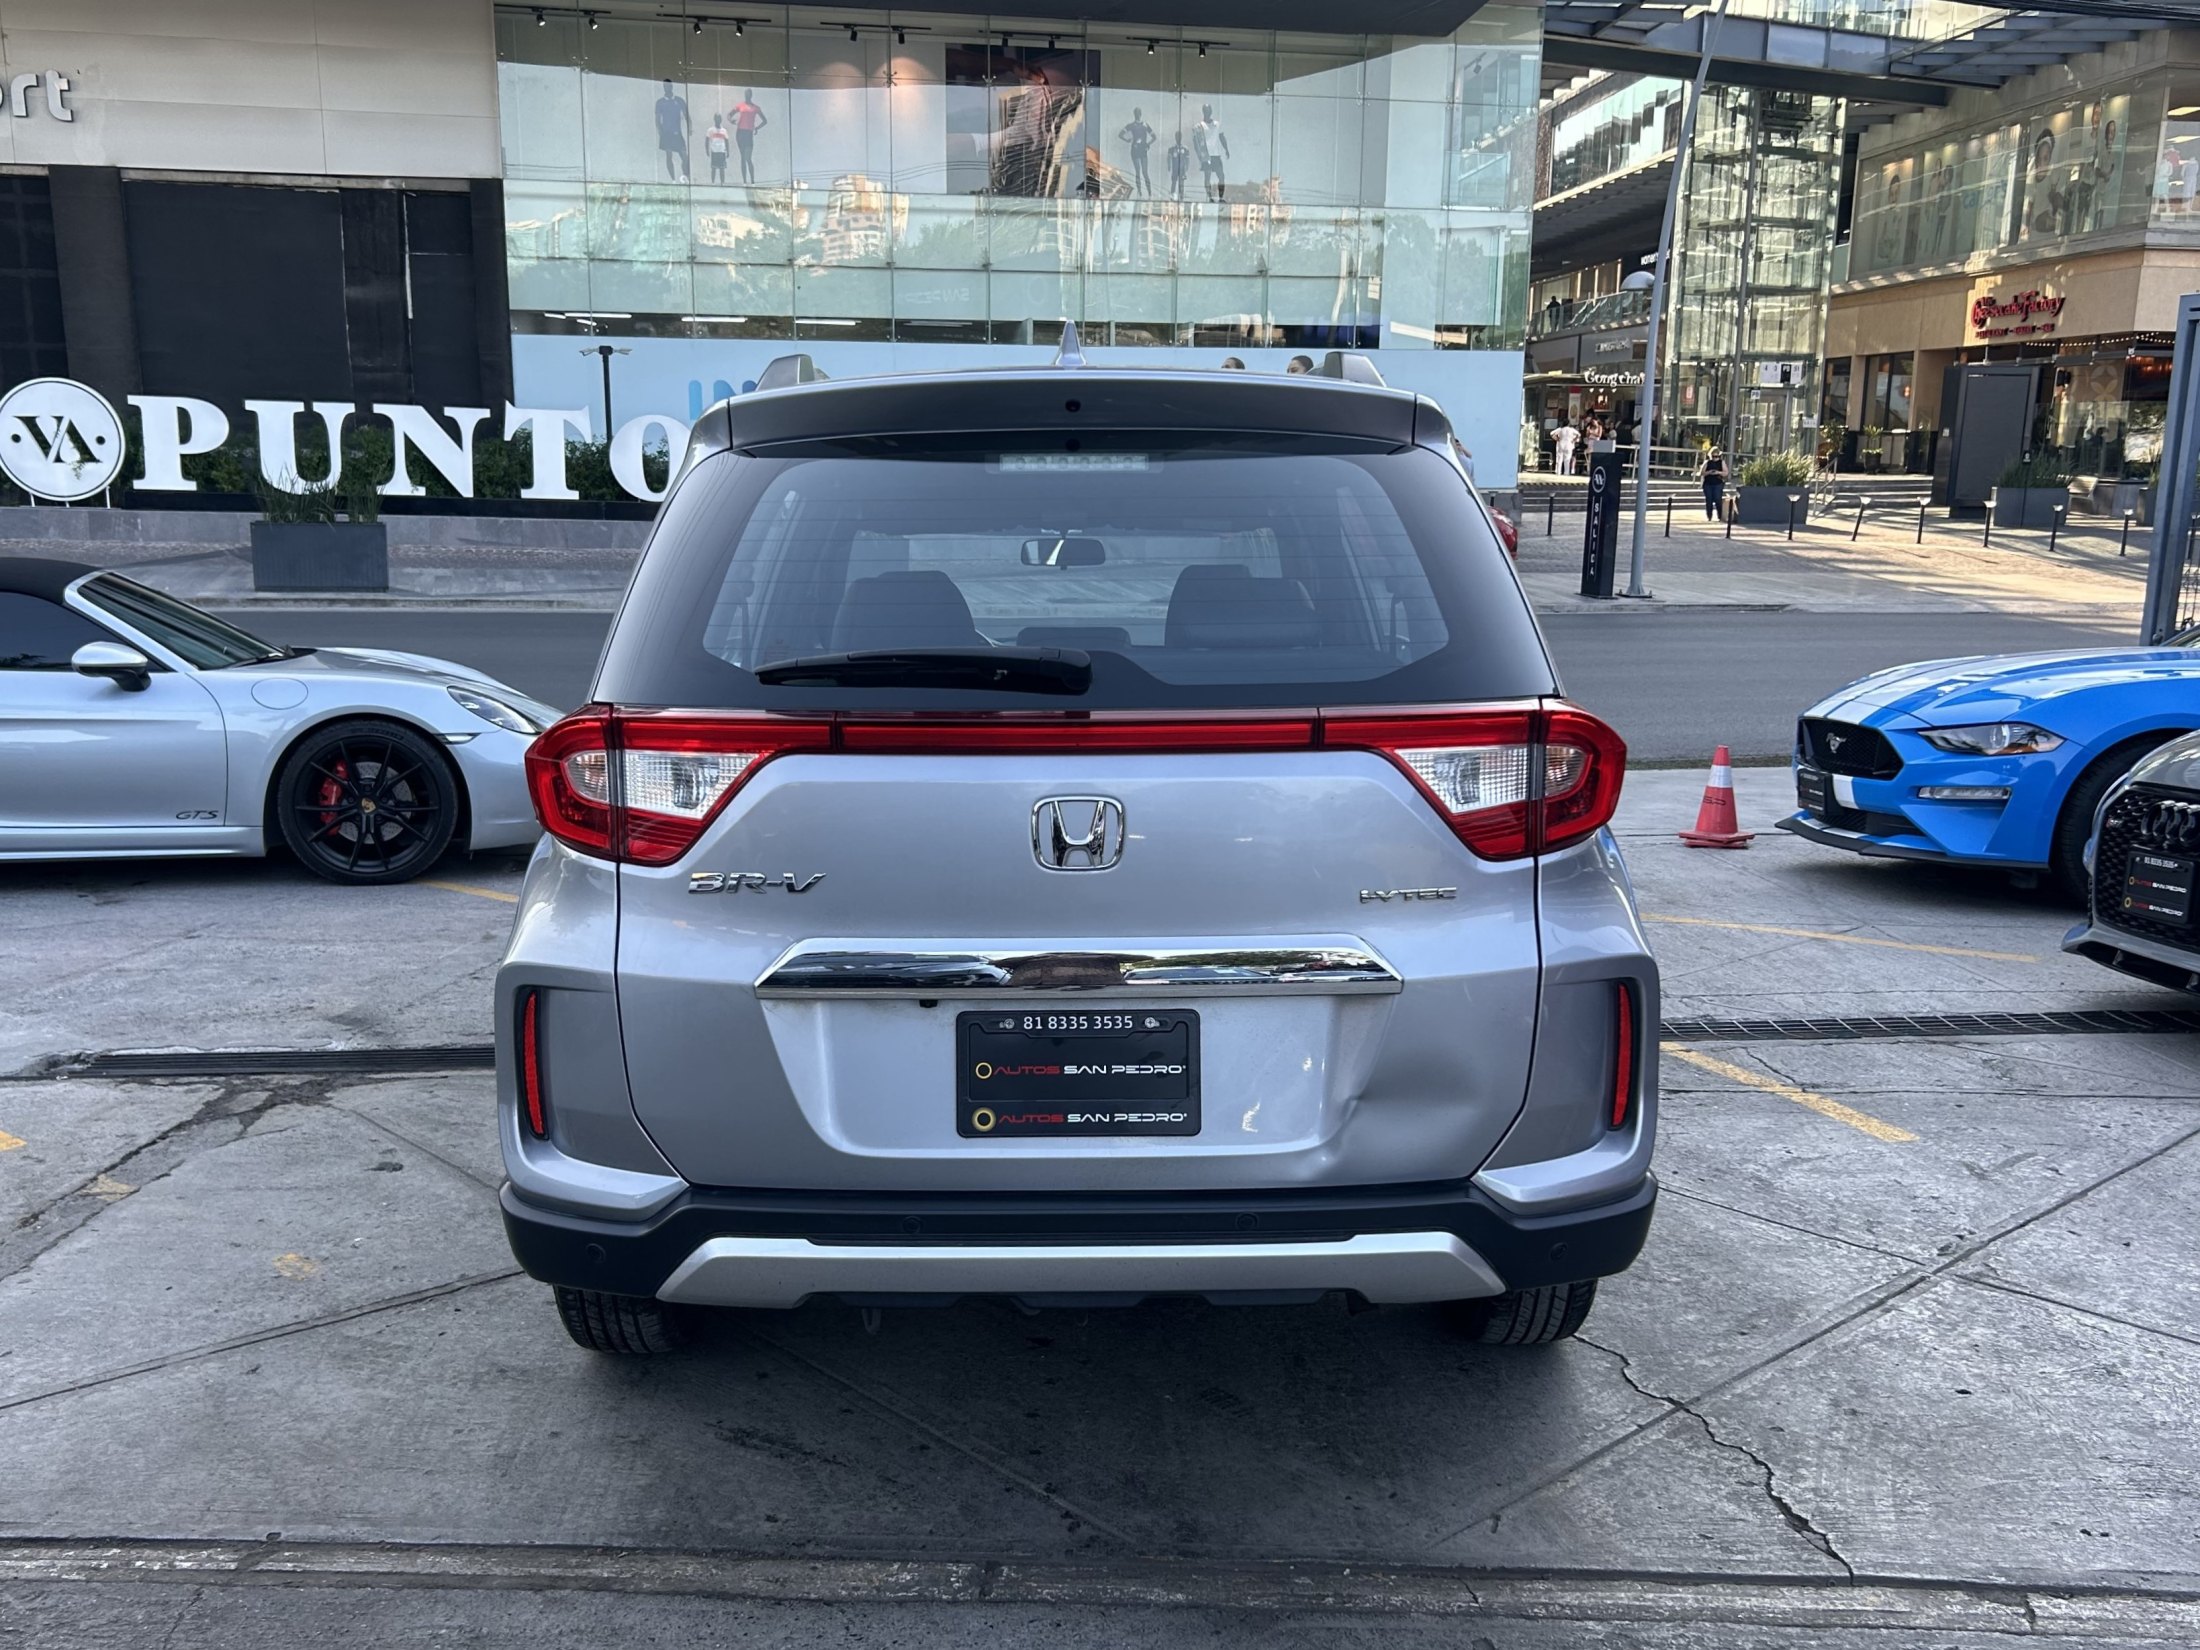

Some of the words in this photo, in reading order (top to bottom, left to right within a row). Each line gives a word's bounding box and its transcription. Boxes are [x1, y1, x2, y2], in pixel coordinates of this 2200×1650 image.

[0, 69, 74, 122] rt
[1584, 367, 1618, 387] Gong
[127, 394, 692, 502] PUNTO
[176, 810, 219, 820] GTS
[688, 872, 827, 894] BR-V
[1023, 1016, 1043, 1030] 81
[1048, 1016, 1088, 1029] 8335
[1093, 1015, 1133, 1029] 3535
[994, 1066, 1060, 1075] AUTOS
[1063, 1065, 1107, 1074] SAN
[999, 1114, 1064, 1123] AUTOS
[1067, 1113, 1110, 1123] SAN
